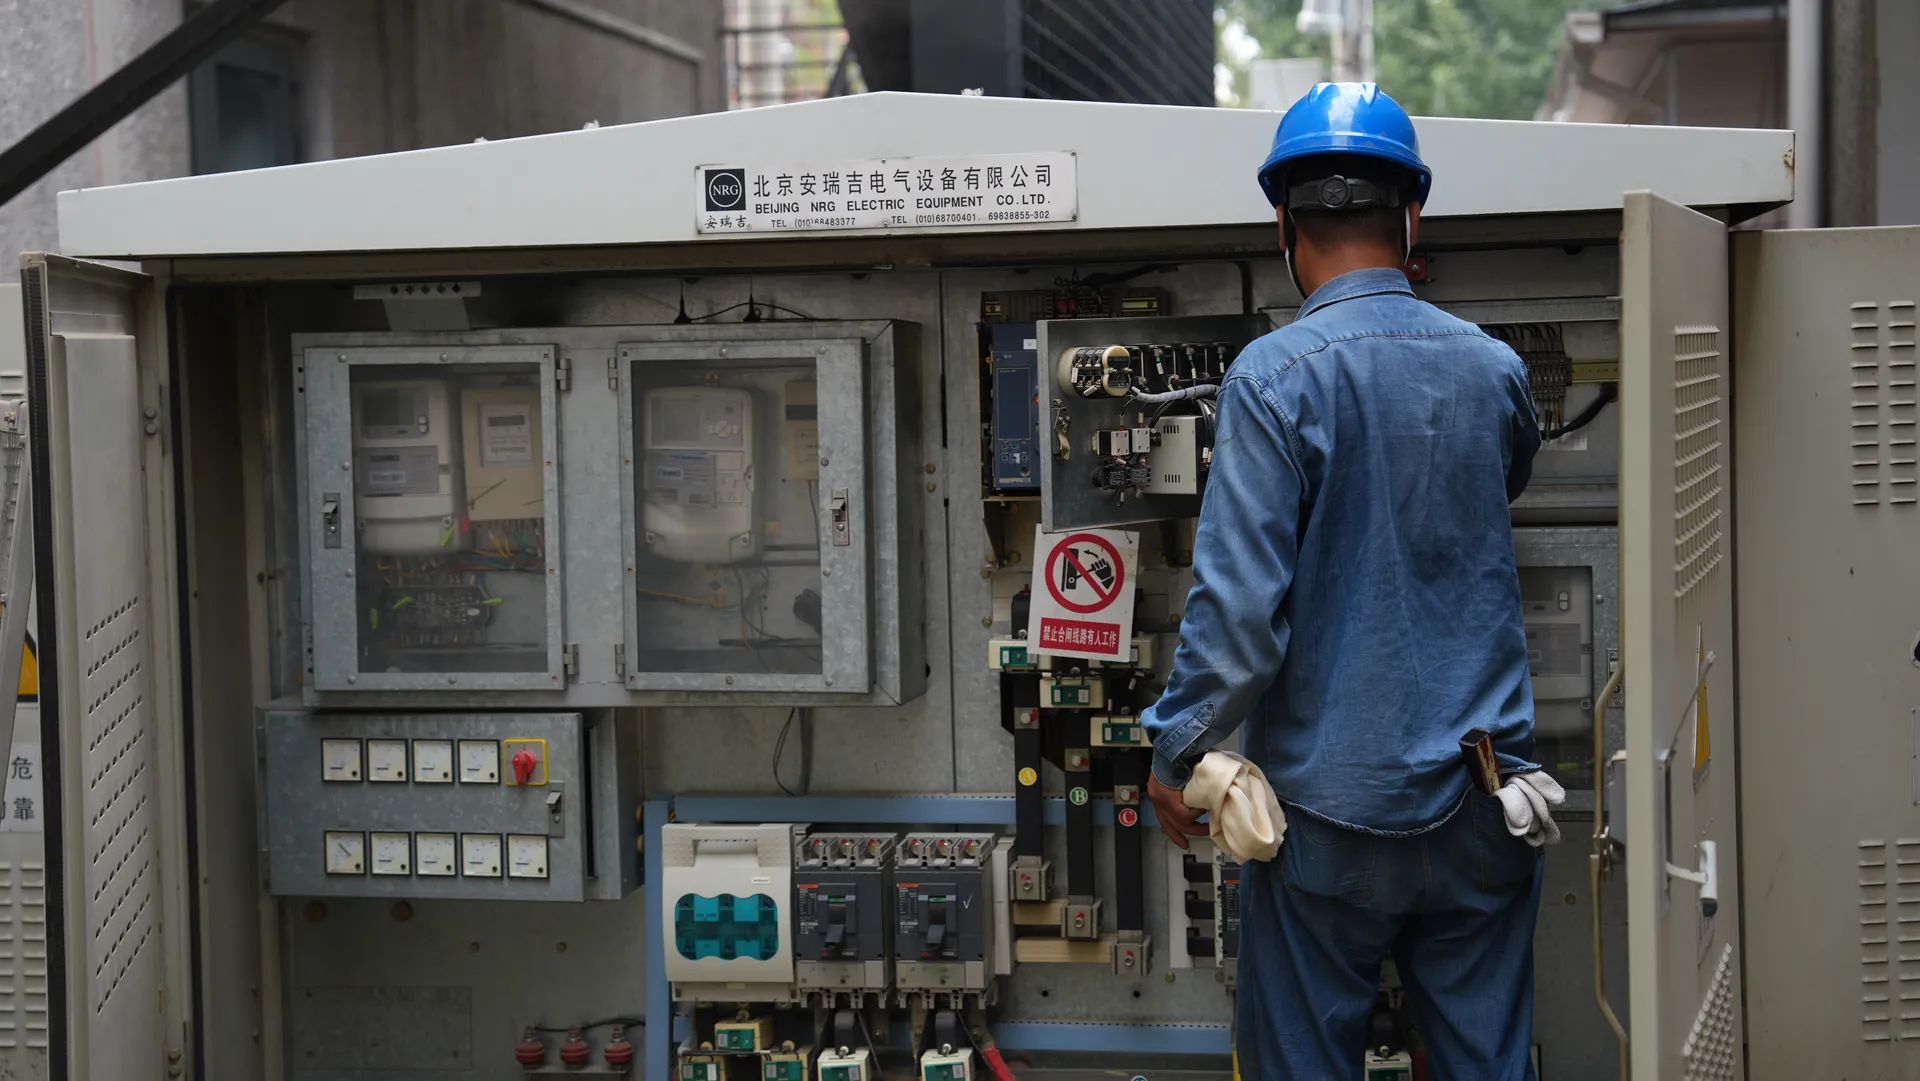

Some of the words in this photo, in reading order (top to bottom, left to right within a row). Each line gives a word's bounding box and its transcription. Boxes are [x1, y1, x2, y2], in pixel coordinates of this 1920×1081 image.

[713, 184, 739, 196] NRG
[753, 164, 1051, 198] 北京安瑞吉电气设备有限公司
[755, 202, 800, 214] BEIJING
[811, 201, 836, 212] NRG
[847, 199, 905, 212] ELECTRIC
[916, 195, 984, 209] EQUIPMENT
[704, 214, 747, 229] 安瑞吉
[988, 210, 1050, 221] 69838855-302
[1043, 624, 1117, 648] 禁止合闸线路有人工作
[11, 756, 33, 780] 危
